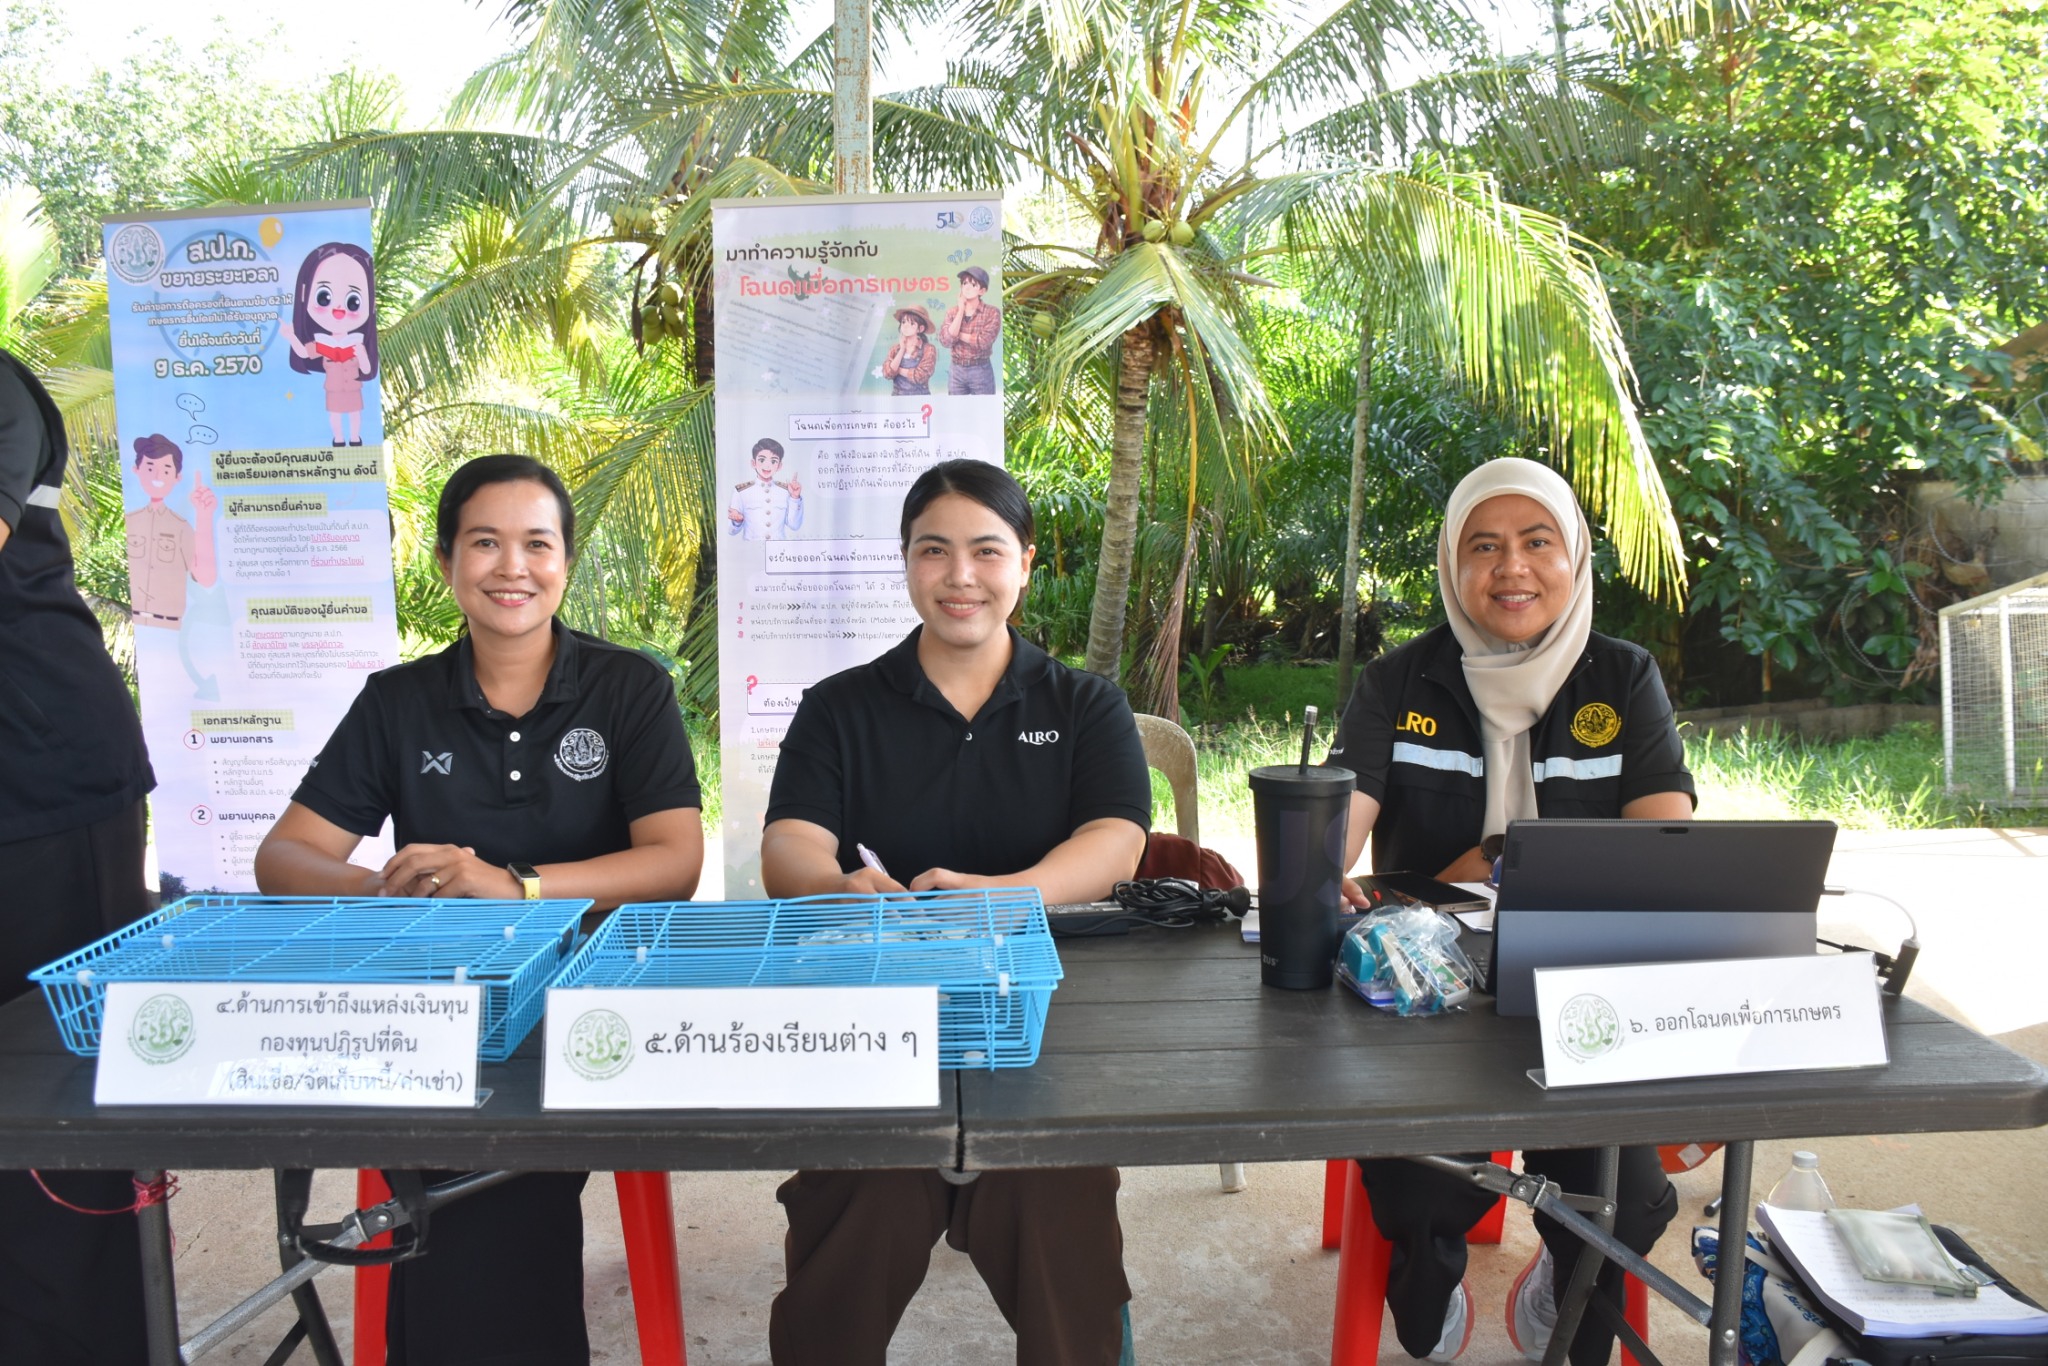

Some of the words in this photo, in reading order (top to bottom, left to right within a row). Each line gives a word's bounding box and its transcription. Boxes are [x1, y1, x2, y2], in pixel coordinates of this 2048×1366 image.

[187, 231, 256, 264] ส.ป.ก.
[725, 240, 879, 264] มาทำความรู้จักกับ
[160, 266, 278, 288] ขยายระยะเวลา
[740, 267, 950, 297] โฉนดเพื่อการเกษตร
[268, 297, 281, 306] 62
[178, 328, 261, 348] ยื่นได้จนถึงวันที่
[172, 362, 209, 377] ธ.ค.
[213, 356, 262, 376] 2570
[794, 418, 878, 431] โฉนดเพื่อการเกษตร
[883, 418, 916, 430] คืออะไร
[215, 450, 334, 470] ผู้ยื่นจะต้องมีคุณสมบัติ
[216, 465, 350, 480] และเตรียมเอกสารหลักฐาน
[353, 460, 378, 476] ดังนี้
[228, 500, 323, 516] ผู้ที่สามารถยื่นคำขอ
[251, 601, 368, 620] คุณสมบัติของผู้ยื่นคำขอ
[203, 714, 282, 727] เอกสาร/หลักฐาน
[1396, 711, 1437, 737] LRO
[191, 733, 198, 745] 1
[210, 735, 274, 744] พยานเอกสาร
[1018, 730, 1060, 746] ALRO
[197, 809, 206, 821] 2
[218, 811, 276, 822] พยานบุคคล
[215, 992, 470, 1022] ๔.ด้านการเข้าถึงแหล่งเงินทุน
[1629, 1016, 1649, 1034] ๖.
[1654, 999, 1843, 1033] ออกโฉนดเพื่อการเกษตร
[260, 1025, 419, 1059] กองทุนปฏิรูปที่ดิน
[644, 1022, 887, 1055] ๕.ด้านร้องเรียนต่าง
[901, 1030, 918, 1058] ๆ
